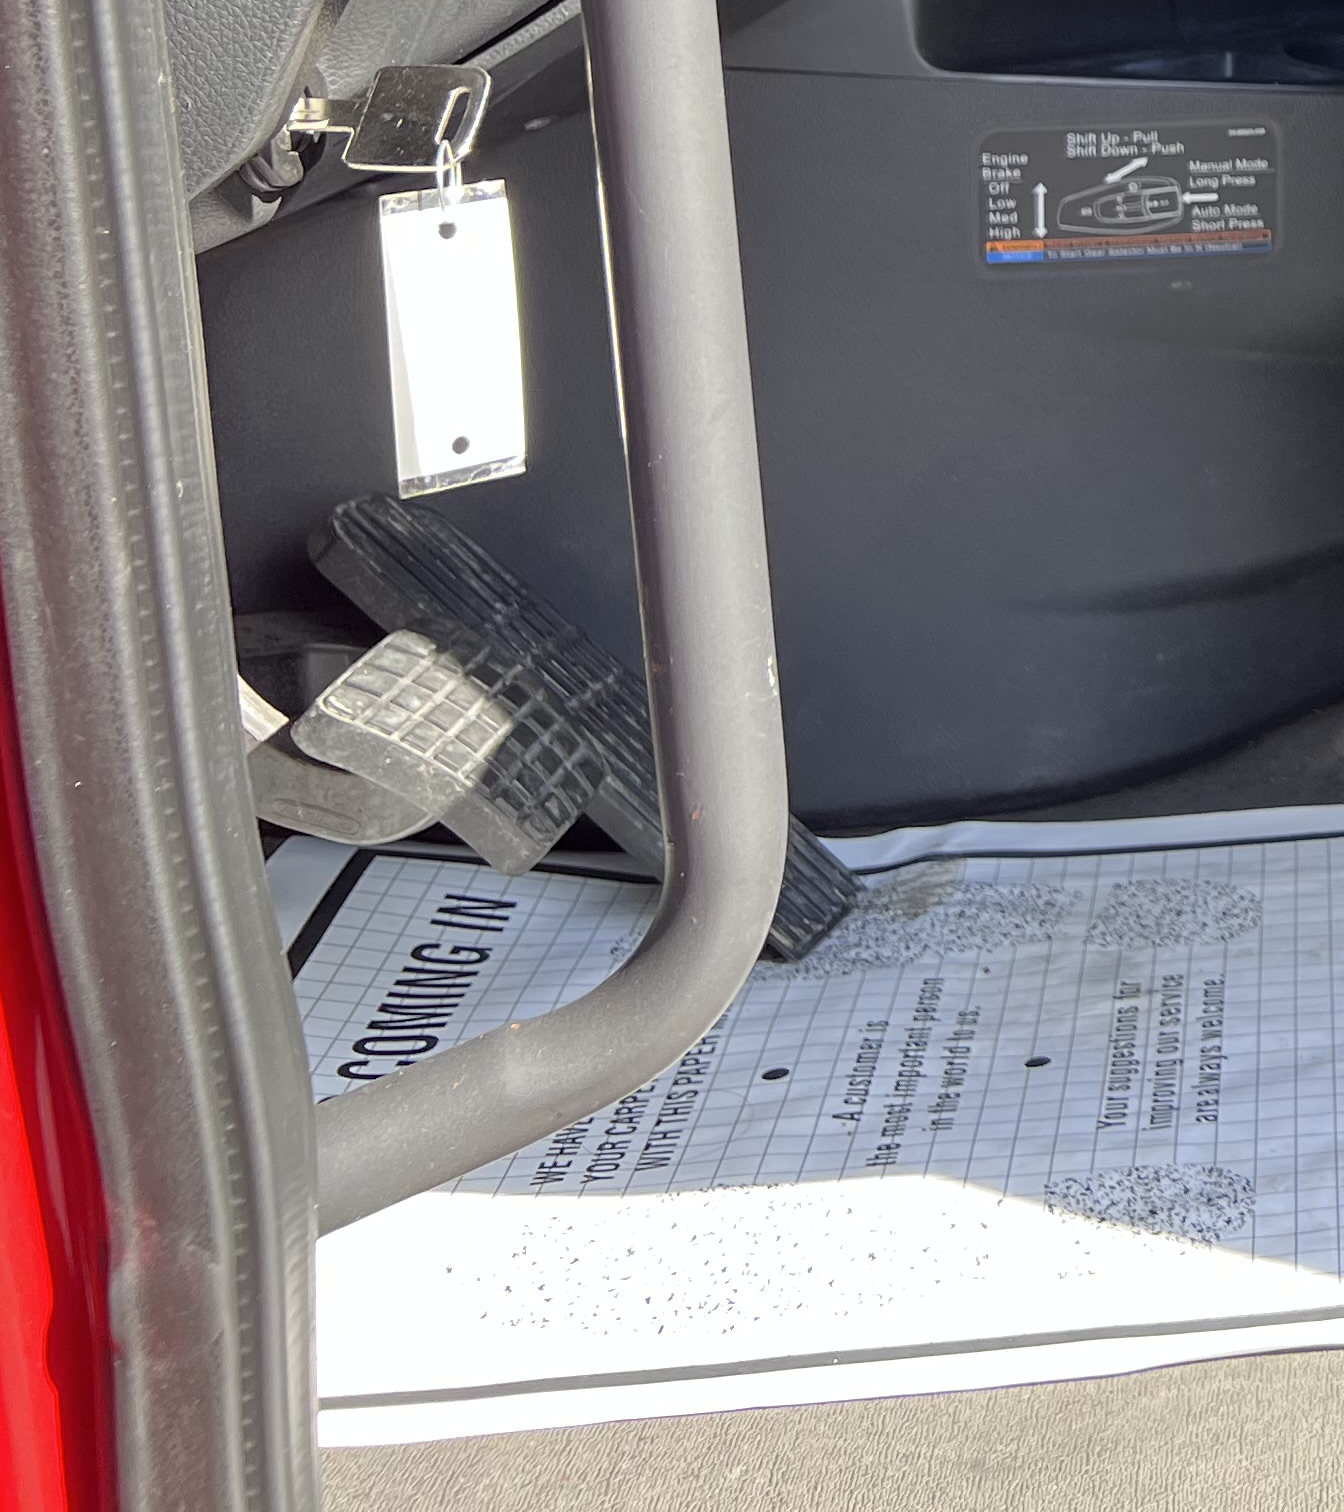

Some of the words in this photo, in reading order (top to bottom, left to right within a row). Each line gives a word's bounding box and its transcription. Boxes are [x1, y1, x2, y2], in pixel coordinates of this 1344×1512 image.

[1066, 132, 1096, 145] Shift
[1101, 131, 1120, 146] Up
[1133, 130, 1158, 144] Pull
[982, 152, 1029, 168] Engine
[1066, 144, 1096, 158] Shift
[1101, 143, 1138, 157] Down
[1151, 141, 1184, 155] Push
[982, 167, 1022, 180] Brake
[1189, 158, 1233, 171] Manual
[1235, 157, 1269, 170] Mode
[988, 181, 1010, 195] Off
[1189, 175, 1220, 190] Long
[1222, 174, 1256, 186] Press
[988, 197, 1017, 210] Low
[1192, 205, 1221, 217] Auto
[1224, 203, 1259, 216] Mode
[988, 212, 1018, 225] Med
[1192, 219, 1226, 232] Short
[1228, 217, 1264, 230] Press
[988, 226, 1021, 240] High
[336, 943, 493, 1080] COMING
[429, 893, 517, 932] IN
[1112, 981, 1142, 1000] for
[913, 978, 944, 1022] person
[1154, 973, 1184, 1026] service
[1196, 973, 1226, 1041] welcome.
[858, 1020, 889, 1033] is
[957, 1005, 981, 1026] us.
[946, 1030, 976, 1041] to
[1157, 1031, 1181, 1054] our
[1108, 1005, 1140, 1092] suggestions
[844, 1037, 884, 1105] customer
[884, 1026, 932, 1097] important
[940, 1046, 972, 1088] world
[1191, 1045, 1228, 1095] always
[927, 1092, 961, 1113] the
[1142, 1059, 1184, 1132] improving
[655, 1090, 698, 1128] THIS
[831, 1110, 864, 1122] A
[881, 1103, 913, 1137] most
[1096, 1096, 1129, 1130] Your
[1196, 1098, 1219, 1123] are
[922, 1118, 955, 1131] in
[634, 1129, 683, 1172] WITH
[866, 1143, 901, 1167] the
[530, 1159, 573, 1186] WE
[580, 1139, 632, 1185] YOUR
